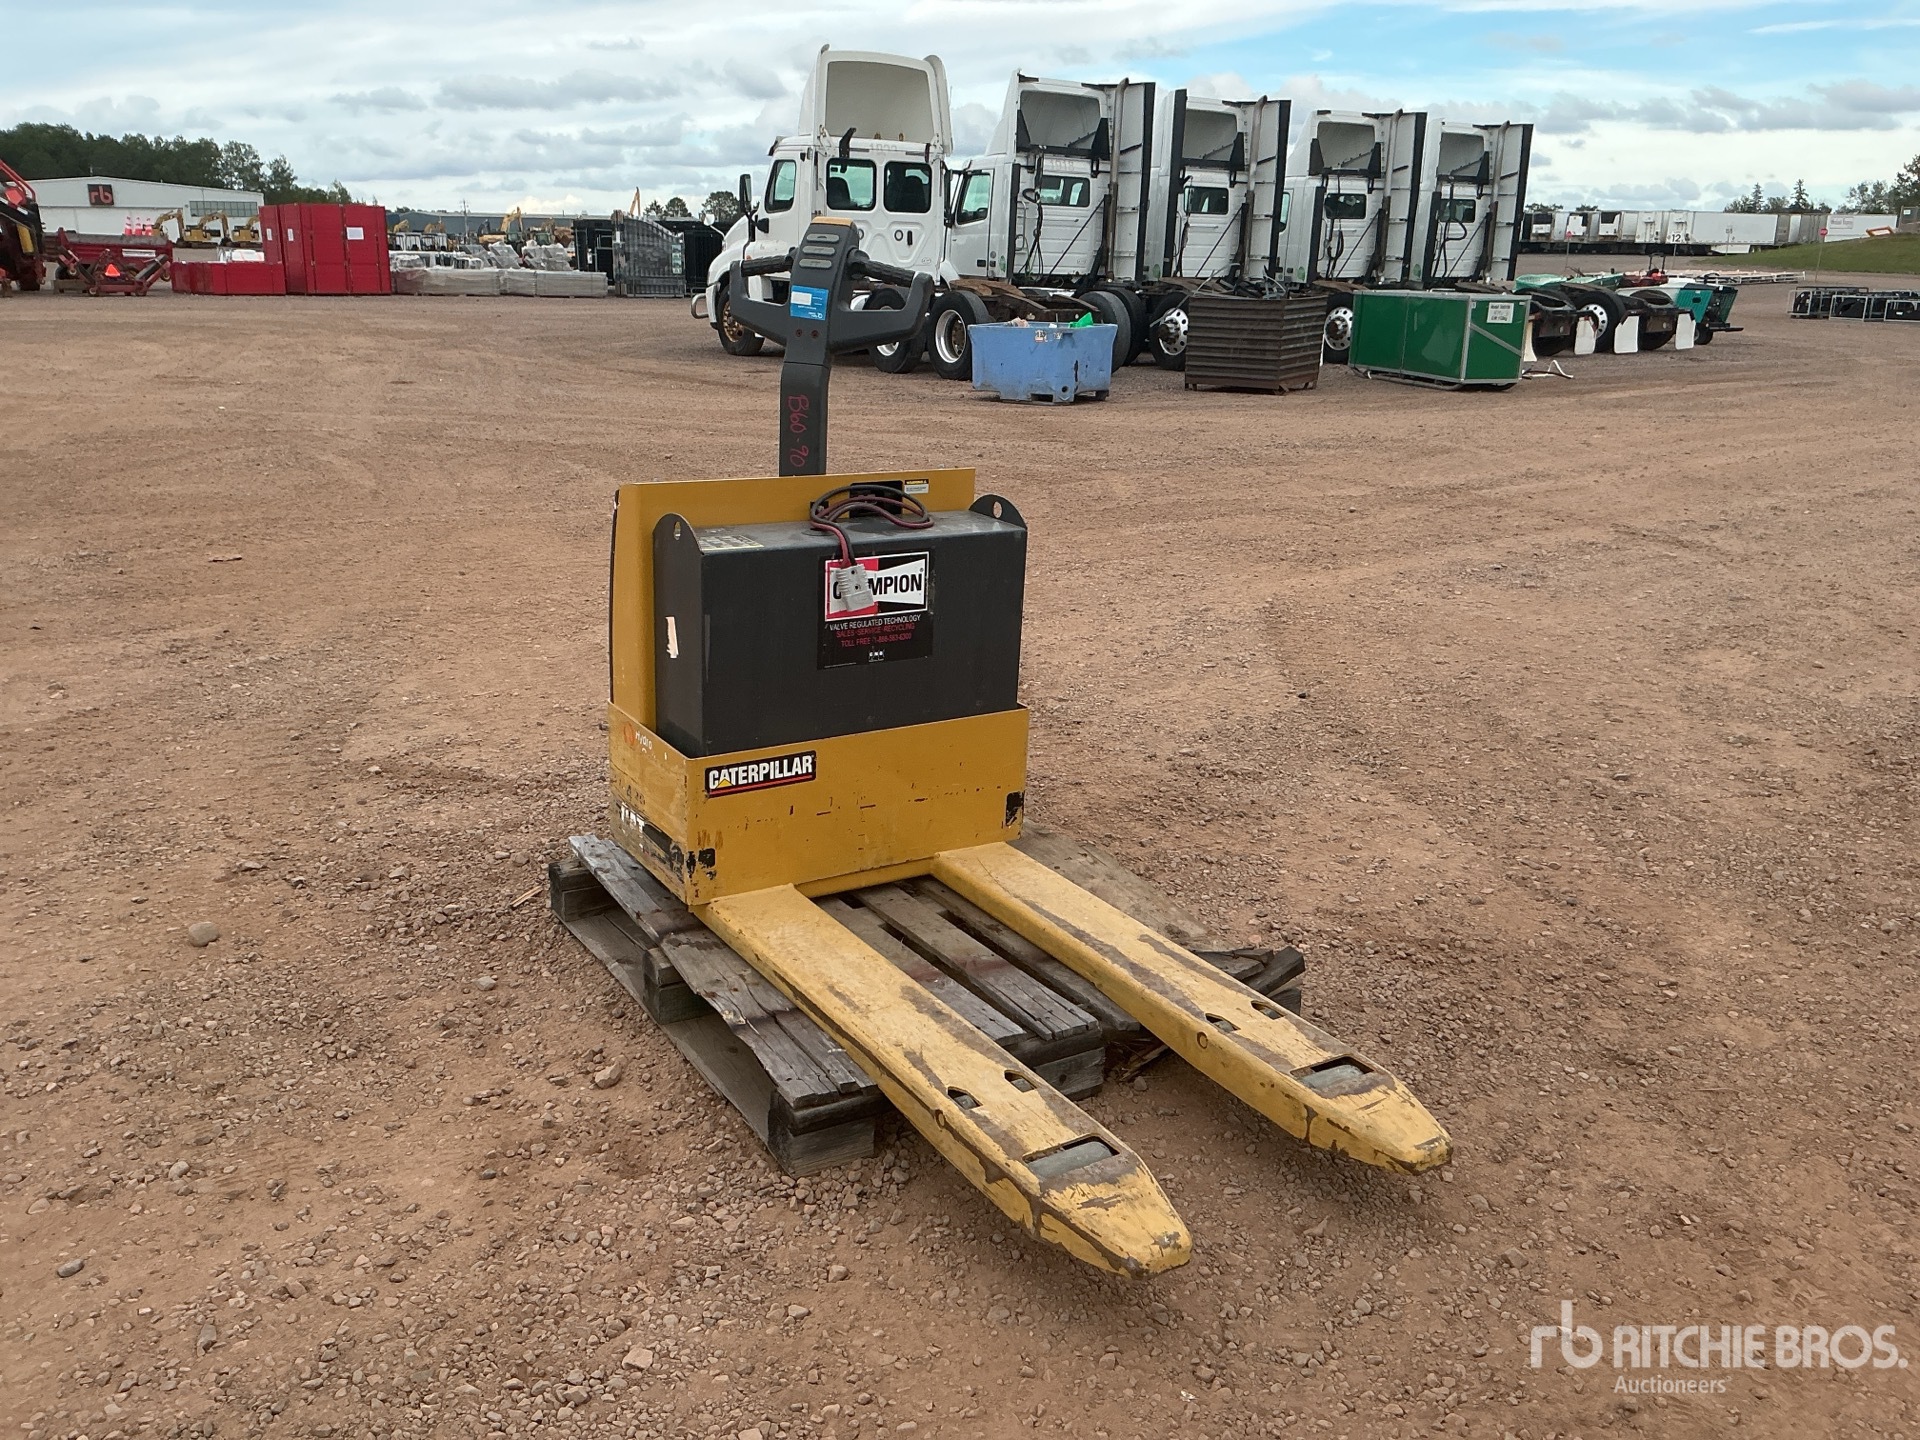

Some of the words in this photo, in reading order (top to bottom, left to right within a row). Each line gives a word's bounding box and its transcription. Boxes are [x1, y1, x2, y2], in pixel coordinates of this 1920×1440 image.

[90, 185, 113, 203] rb
[1671, 233, 1681, 242] 12
[833, 574, 922, 600] CMPION
[829, 622, 849, 631] VALVE
[849, 619, 883, 629] REGULATED
[884, 614, 921, 625] TECHNOLOGY
[836, 629, 855, 638] SALES
[884, 623, 916, 632] RECYCLING
[841, 639, 855, 647] TOLL
[856, 637, 871, 645] FREE
[708, 755, 813, 789] CATERPILLAR
